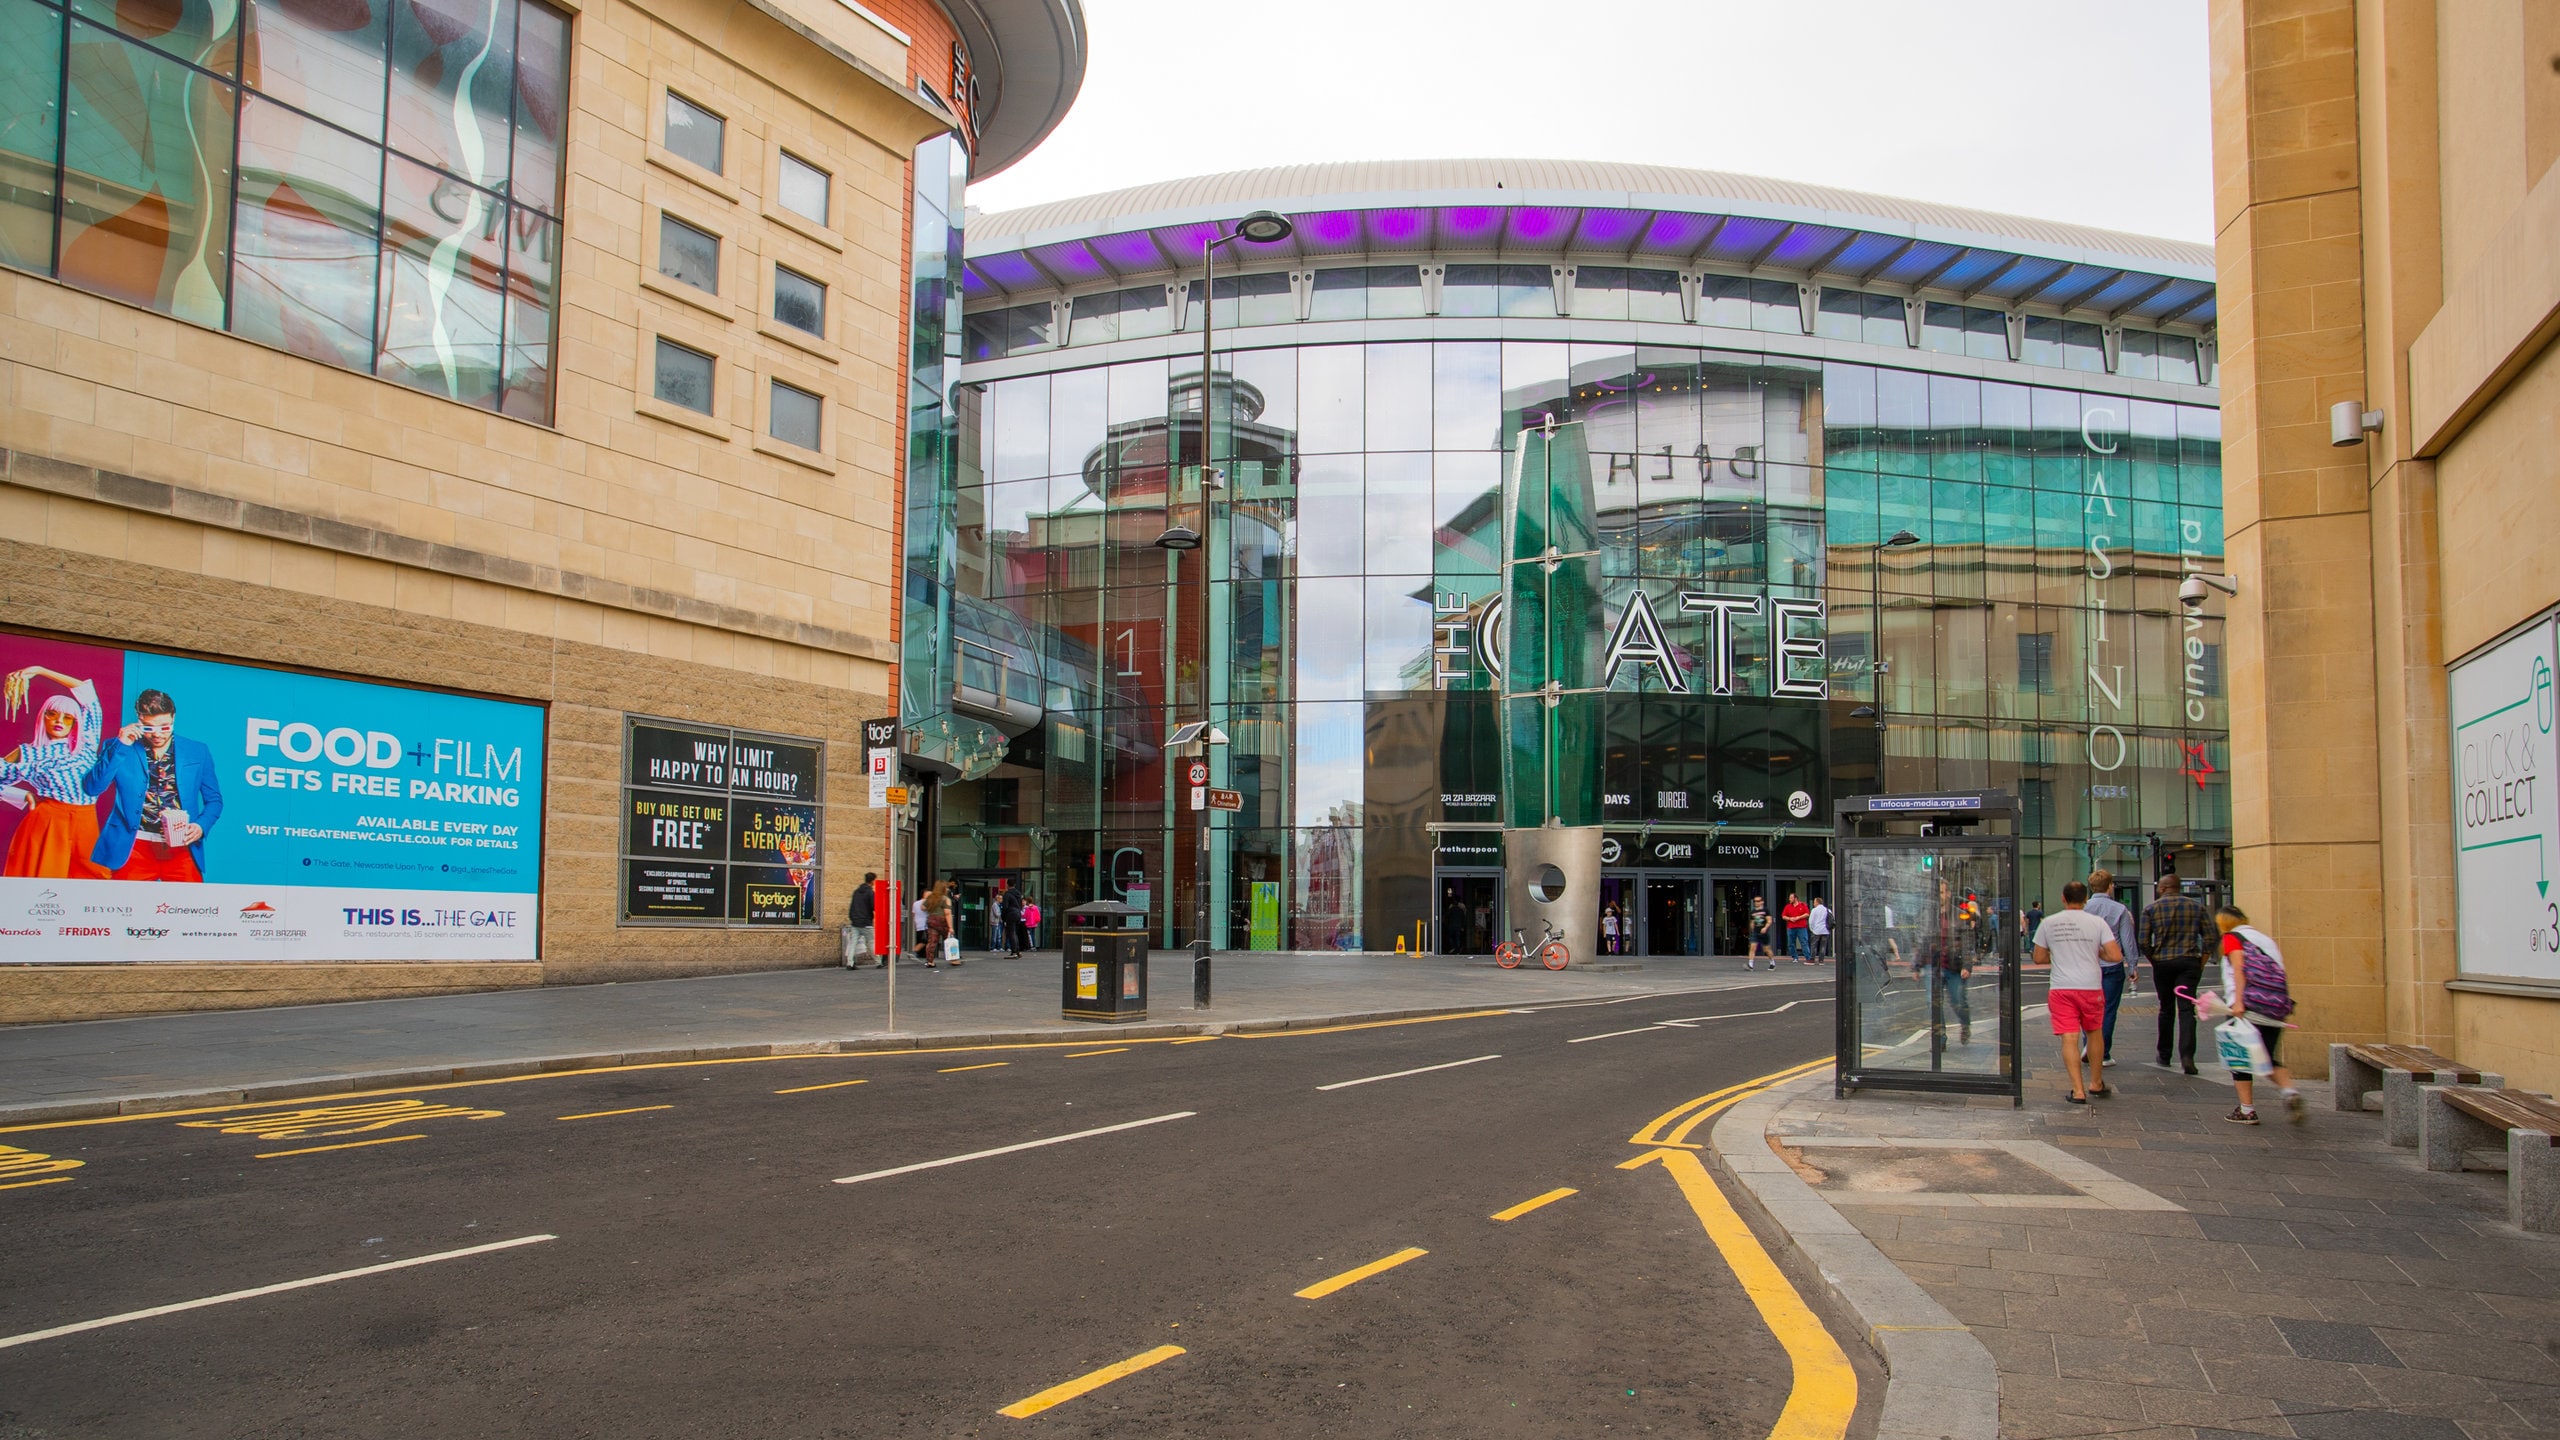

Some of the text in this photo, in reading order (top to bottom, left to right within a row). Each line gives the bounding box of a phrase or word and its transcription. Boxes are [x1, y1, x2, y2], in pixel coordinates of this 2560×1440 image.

[2081, 407, 2127, 772] CASINO
[2181, 519, 2206, 722] cinewrld
[1434, 592, 1471, 690] THE
[1116, 628, 1142, 676] 1
[868, 723, 895, 744] tiger
[246, 717, 402, 769] FOOD
[434, 738, 521, 783] FILM
[694, 741, 774, 769] WHY LIMIT
[2464, 723, 2536, 788] CLICK &
[650, 758, 798, 791] HAPPY TO AN HOUR?
[1192, 769, 1204, 779] 20
[245, 765, 519, 807] GETS FREE PARKING
[1465, 794, 1496, 802] BAZAAR
[1725, 798, 1764, 809] Nando's
[1880, 799, 1968, 809] infocus-media.org.uk
[2465, 775, 2536, 828] COLLECT
[636, 801, 723, 821] BUY ONE GET ONE
[356, 815, 518, 836] AVAILABLE EVERY DAY
[754, 813, 762, 831] 5
[246, 824, 518, 849] VISIT THEGATENEWCASTLE.CO.UK FOR DETAILS
[743, 831, 808, 851] EVERY DAY
[1440, 846, 1498, 854] wetherspoon
[1655, 842, 1692, 860] Opera
[1718, 845, 1760, 855] BEYOND
[1111, 846, 1143, 896] G
[84, 905, 133, 914] BEYOND
[752, 891, 796, 908] tigertiger
[28, 908, 66, 916] CASINO
[167, 905, 219, 915] cineworld
[343, 908, 395, 926] THIS
[469, 910, 516, 928] GATE
[276, 929, 307, 937] BAZAAR
